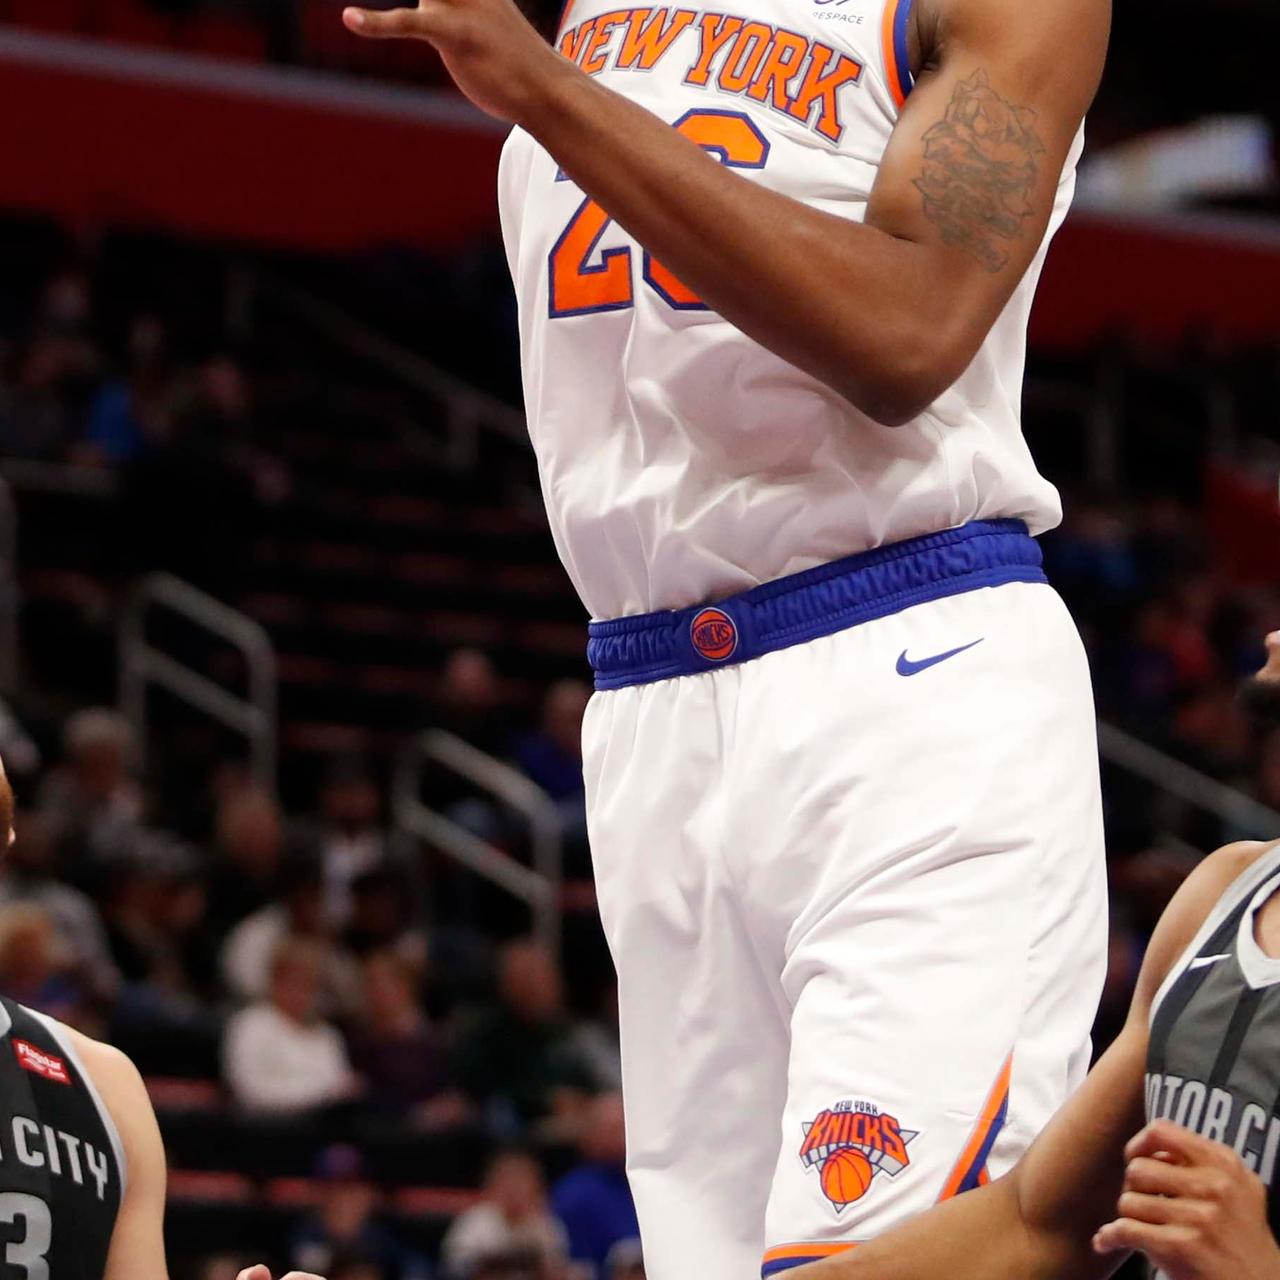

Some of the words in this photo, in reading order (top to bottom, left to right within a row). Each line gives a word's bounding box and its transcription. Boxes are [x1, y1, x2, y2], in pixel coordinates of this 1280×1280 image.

[558, 5, 698, 77] NEW
[681, 8, 867, 147] YORK
[800, 1108, 910, 1167] KNICKS
[834, 1099, 853, 1113] NEW
[854, 1100, 879, 1116] YORK
[1144, 1072, 1243, 1145] OTOR
[11, 1115, 108, 1202] CITY
